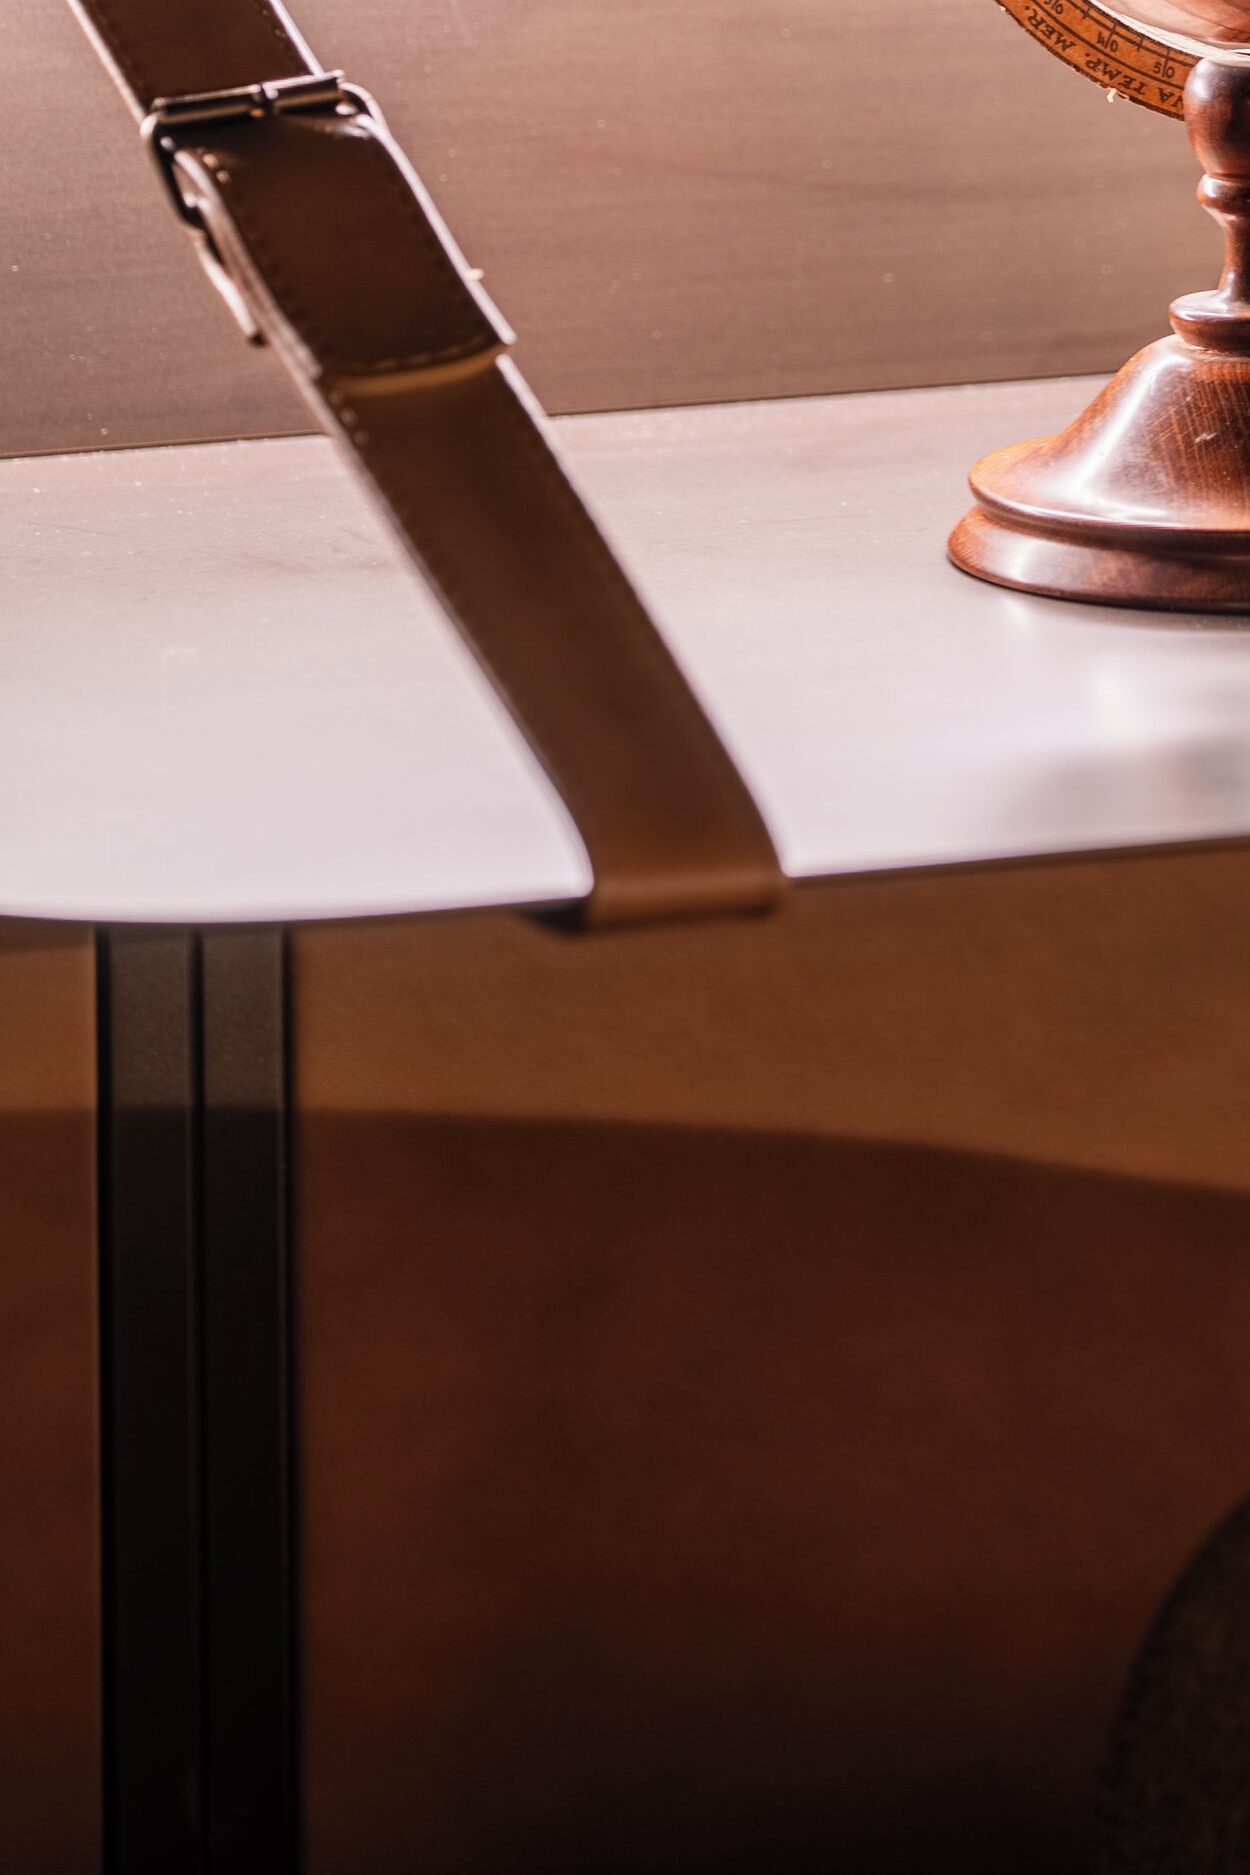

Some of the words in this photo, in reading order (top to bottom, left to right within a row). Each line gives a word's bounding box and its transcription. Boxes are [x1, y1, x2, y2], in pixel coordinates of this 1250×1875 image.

[1024, 5, 1077, 53] MER.
[1084, 52, 1147, 98] TEMP.
[1152, 60, 1175, 79] 50
